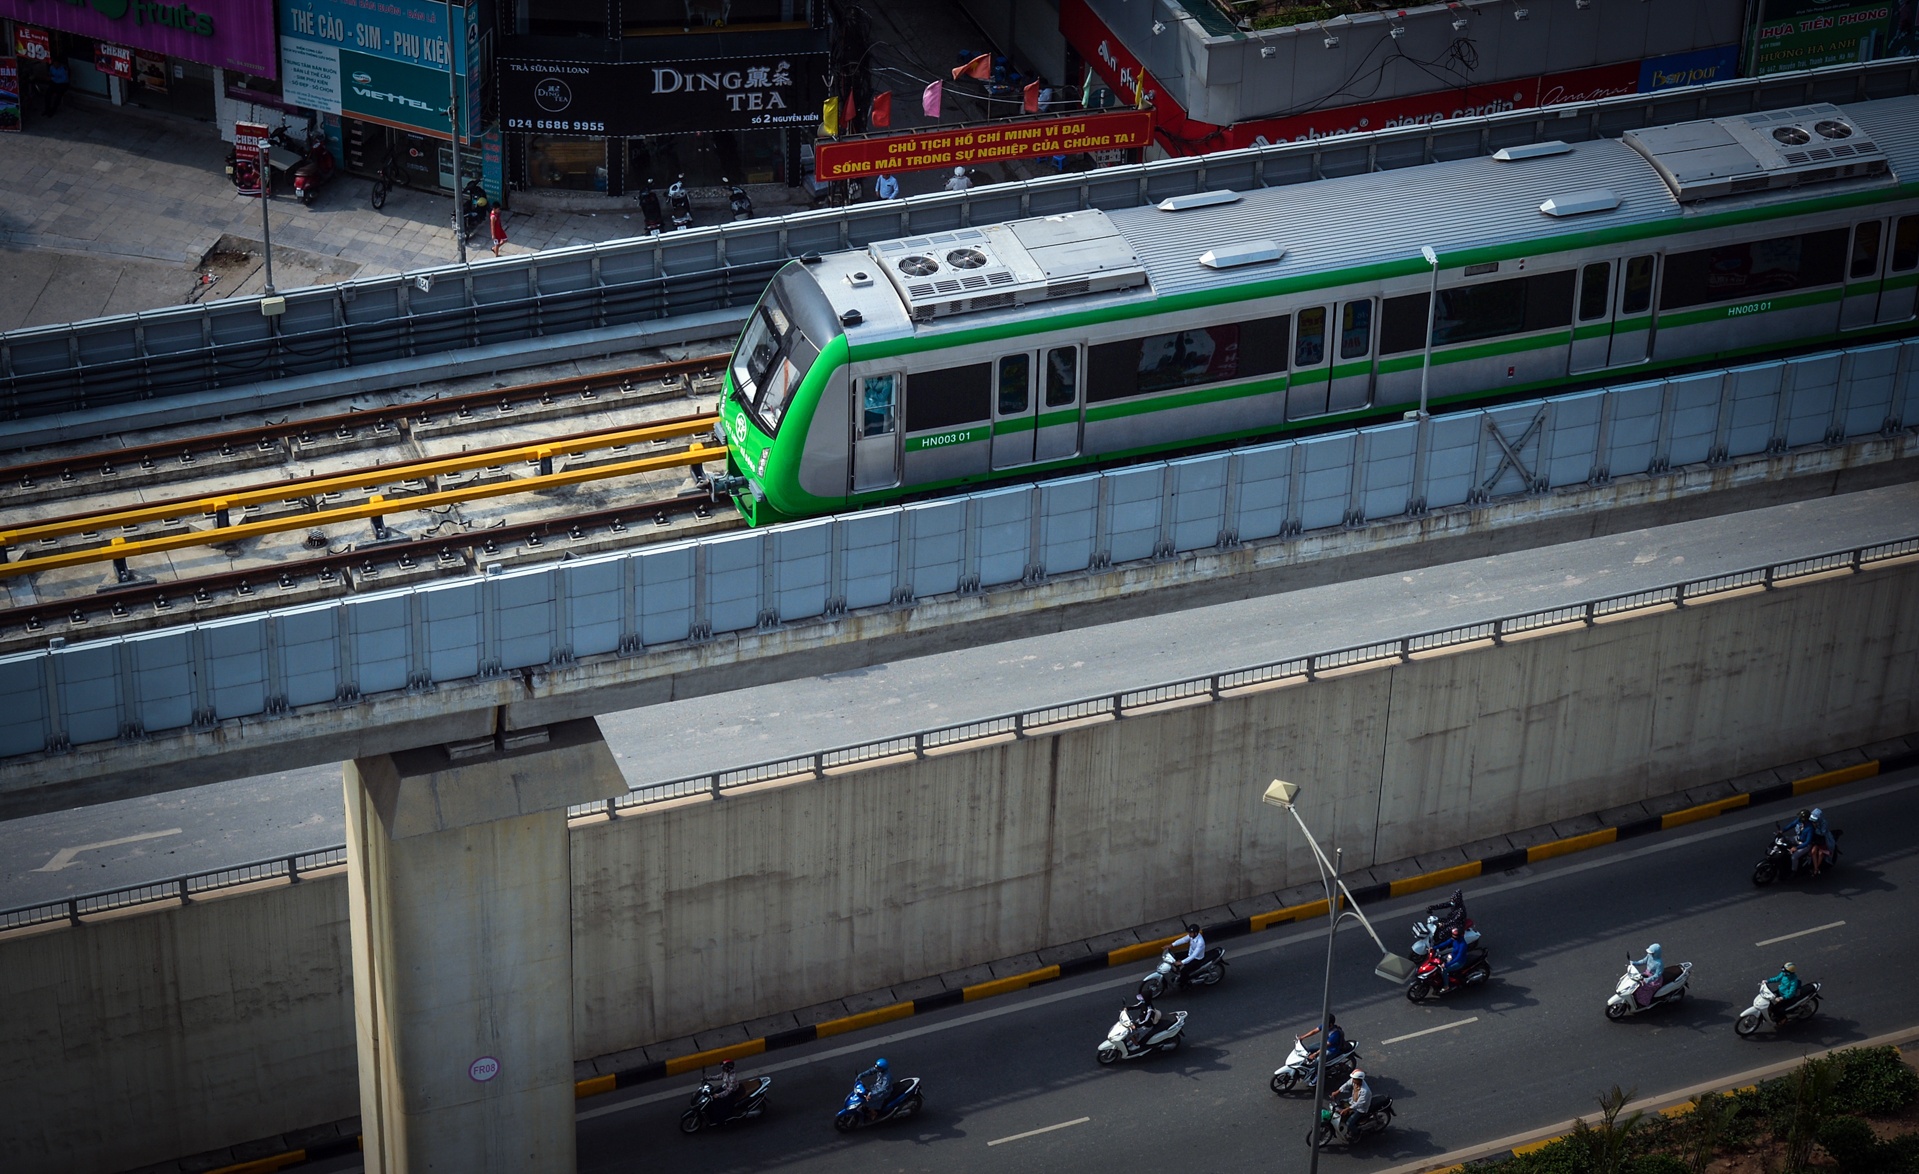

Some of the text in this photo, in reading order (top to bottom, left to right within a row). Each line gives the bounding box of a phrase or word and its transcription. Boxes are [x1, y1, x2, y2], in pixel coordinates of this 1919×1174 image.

[132, 0, 214, 37] fruits
[1838, 8, 1888, 26] PHONG
[291, 2, 315, 35] THẺ
[318, 12, 344, 41] CÀO
[356, 23, 382, 50] SIM
[394, 31, 420, 63] PHỤ
[468, 24, 477, 43] 4
[1759, 48, 1803, 62] HƯƠNG
[1829, 39, 1856, 51] ANH
[510, 63, 529, 71] TRÀ
[566, 66, 590, 74] LOAN
[652, 68, 742, 94] DING
[726, 91, 787, 111] TEA
[508, 118, 605, 132] 024 6686 9955
[763, 114, 771, 123] 2
[236, 134, 270, 146] CHER
[888, 123, 1086, 153] CHỦ TỊCH HỒ CHÍ MINH VĨ ĐẠI
[832, 160, 871, 174] SỐNG
[875, 157, 902, 169] MÃI
[906, 152, 951, 166] TRONG
[955, 148, 975, 162] SỰ
[977, 143, 1029, 158] NGHIỆP
[1032, 138, 1060, 152] CỦA
[1063, 135, 1110, 149] CHÚNG
[1728, 302, 1772, 316] HN003 01
[921, 432, 971, 448] HN003 01
[473, 1063, 496, 1075] FR08
